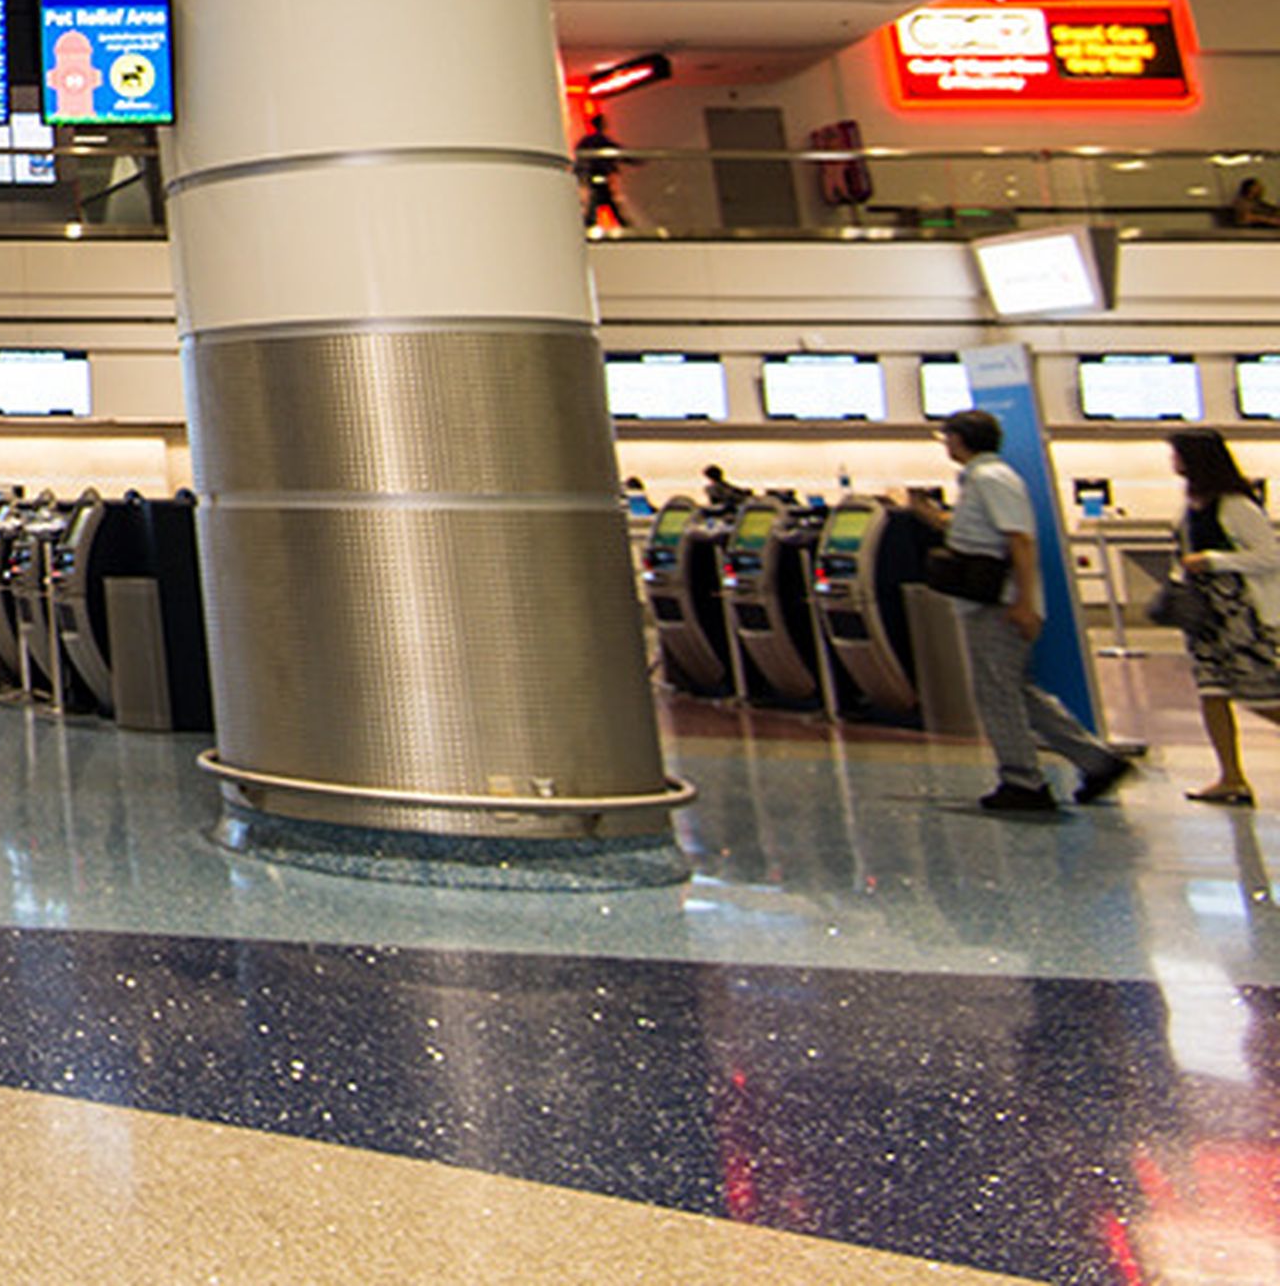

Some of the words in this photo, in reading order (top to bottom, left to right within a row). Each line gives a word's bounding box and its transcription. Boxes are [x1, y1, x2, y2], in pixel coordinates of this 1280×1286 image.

[45, 10, 73, 26] Pet
[76, 8, 124, 26] Relief
[126, 8, 165, 26] Area
